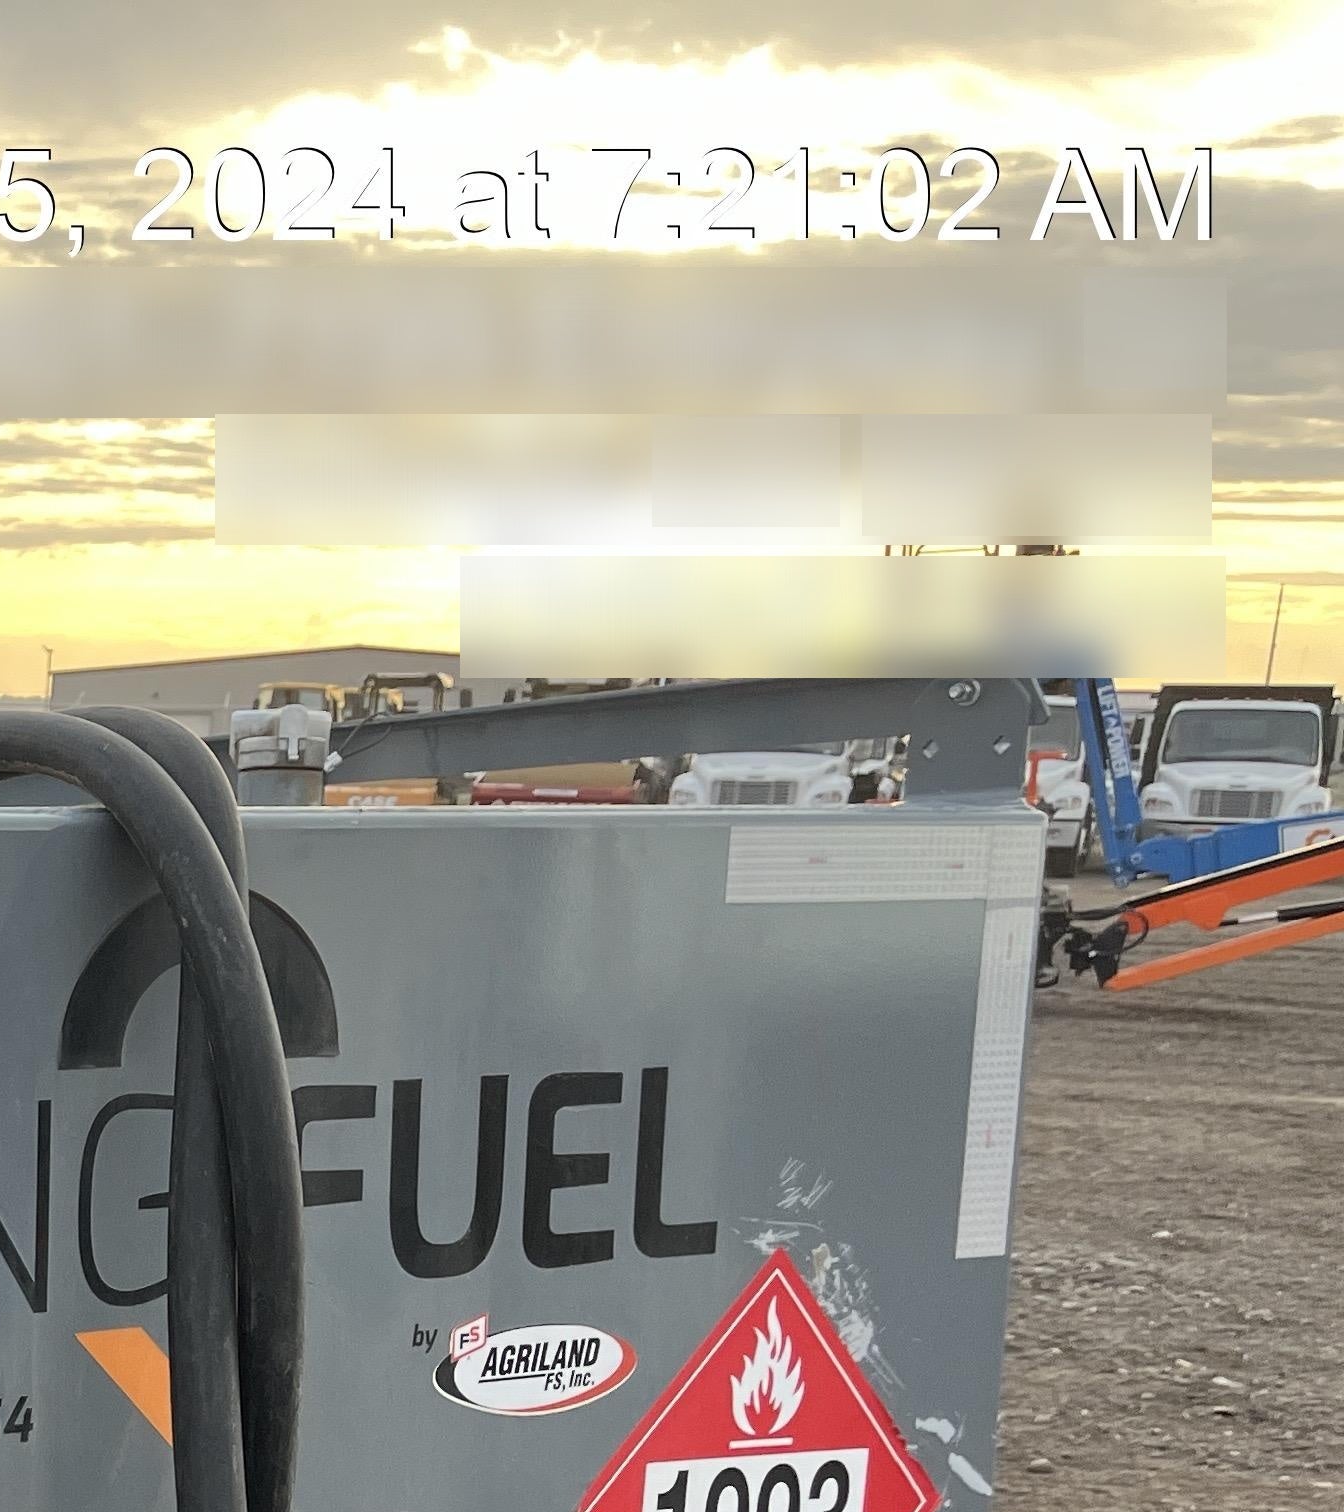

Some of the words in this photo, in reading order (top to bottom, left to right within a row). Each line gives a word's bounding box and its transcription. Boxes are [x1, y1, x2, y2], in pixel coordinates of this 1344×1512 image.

[412, 1323, 438, 1354] by
[459, 1326, 480, 1350] FS
[480, 1336, 601, 1378] AGRILAND
[544, 1373, 566, 1393] FS,
[569, 1370, 596, 1388] Inc.
